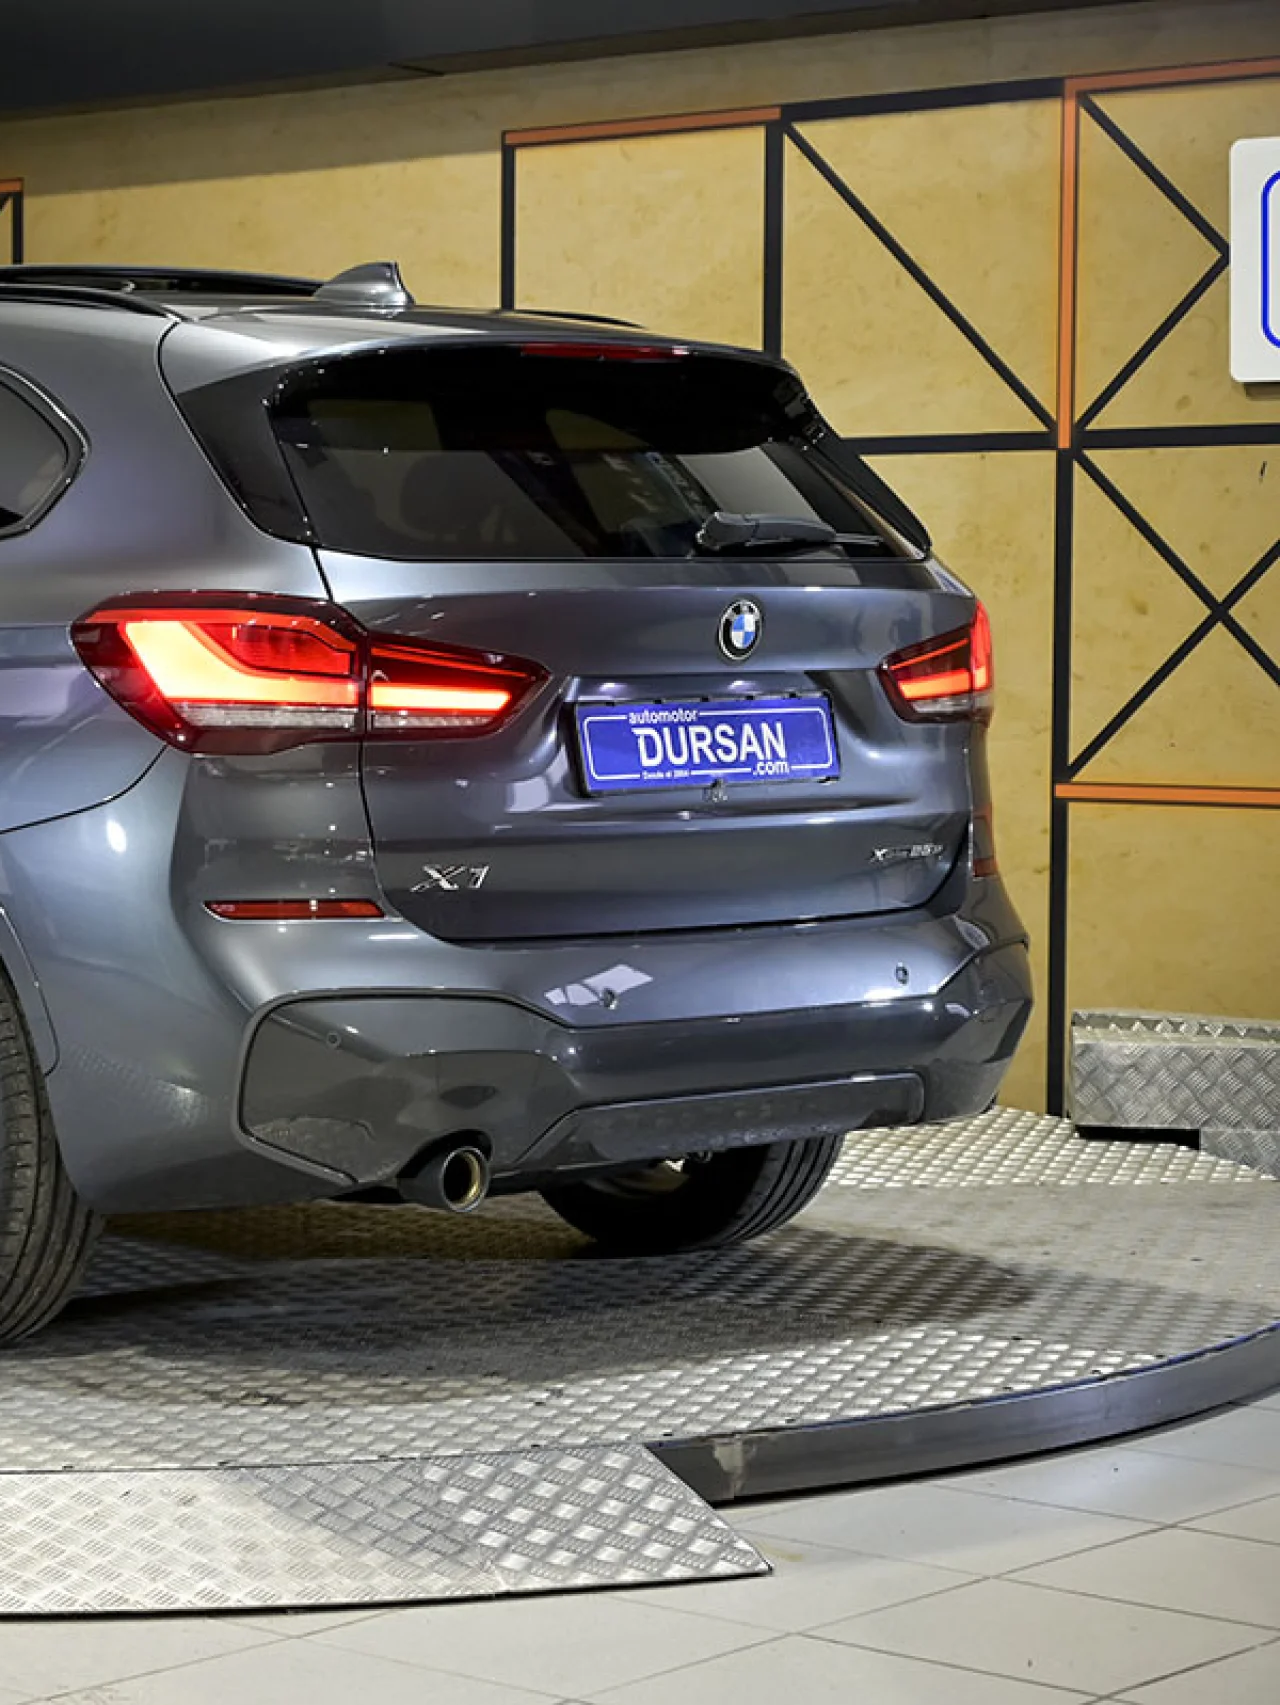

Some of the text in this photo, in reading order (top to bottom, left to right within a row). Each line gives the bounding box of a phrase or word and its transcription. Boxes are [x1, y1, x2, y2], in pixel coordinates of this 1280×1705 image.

[628, 708, 699, 725] automotor
[631, 721, 788, 768] DURSAN
[752, 760, 791, 776] .com
[410, 863, 490, 892] X1
